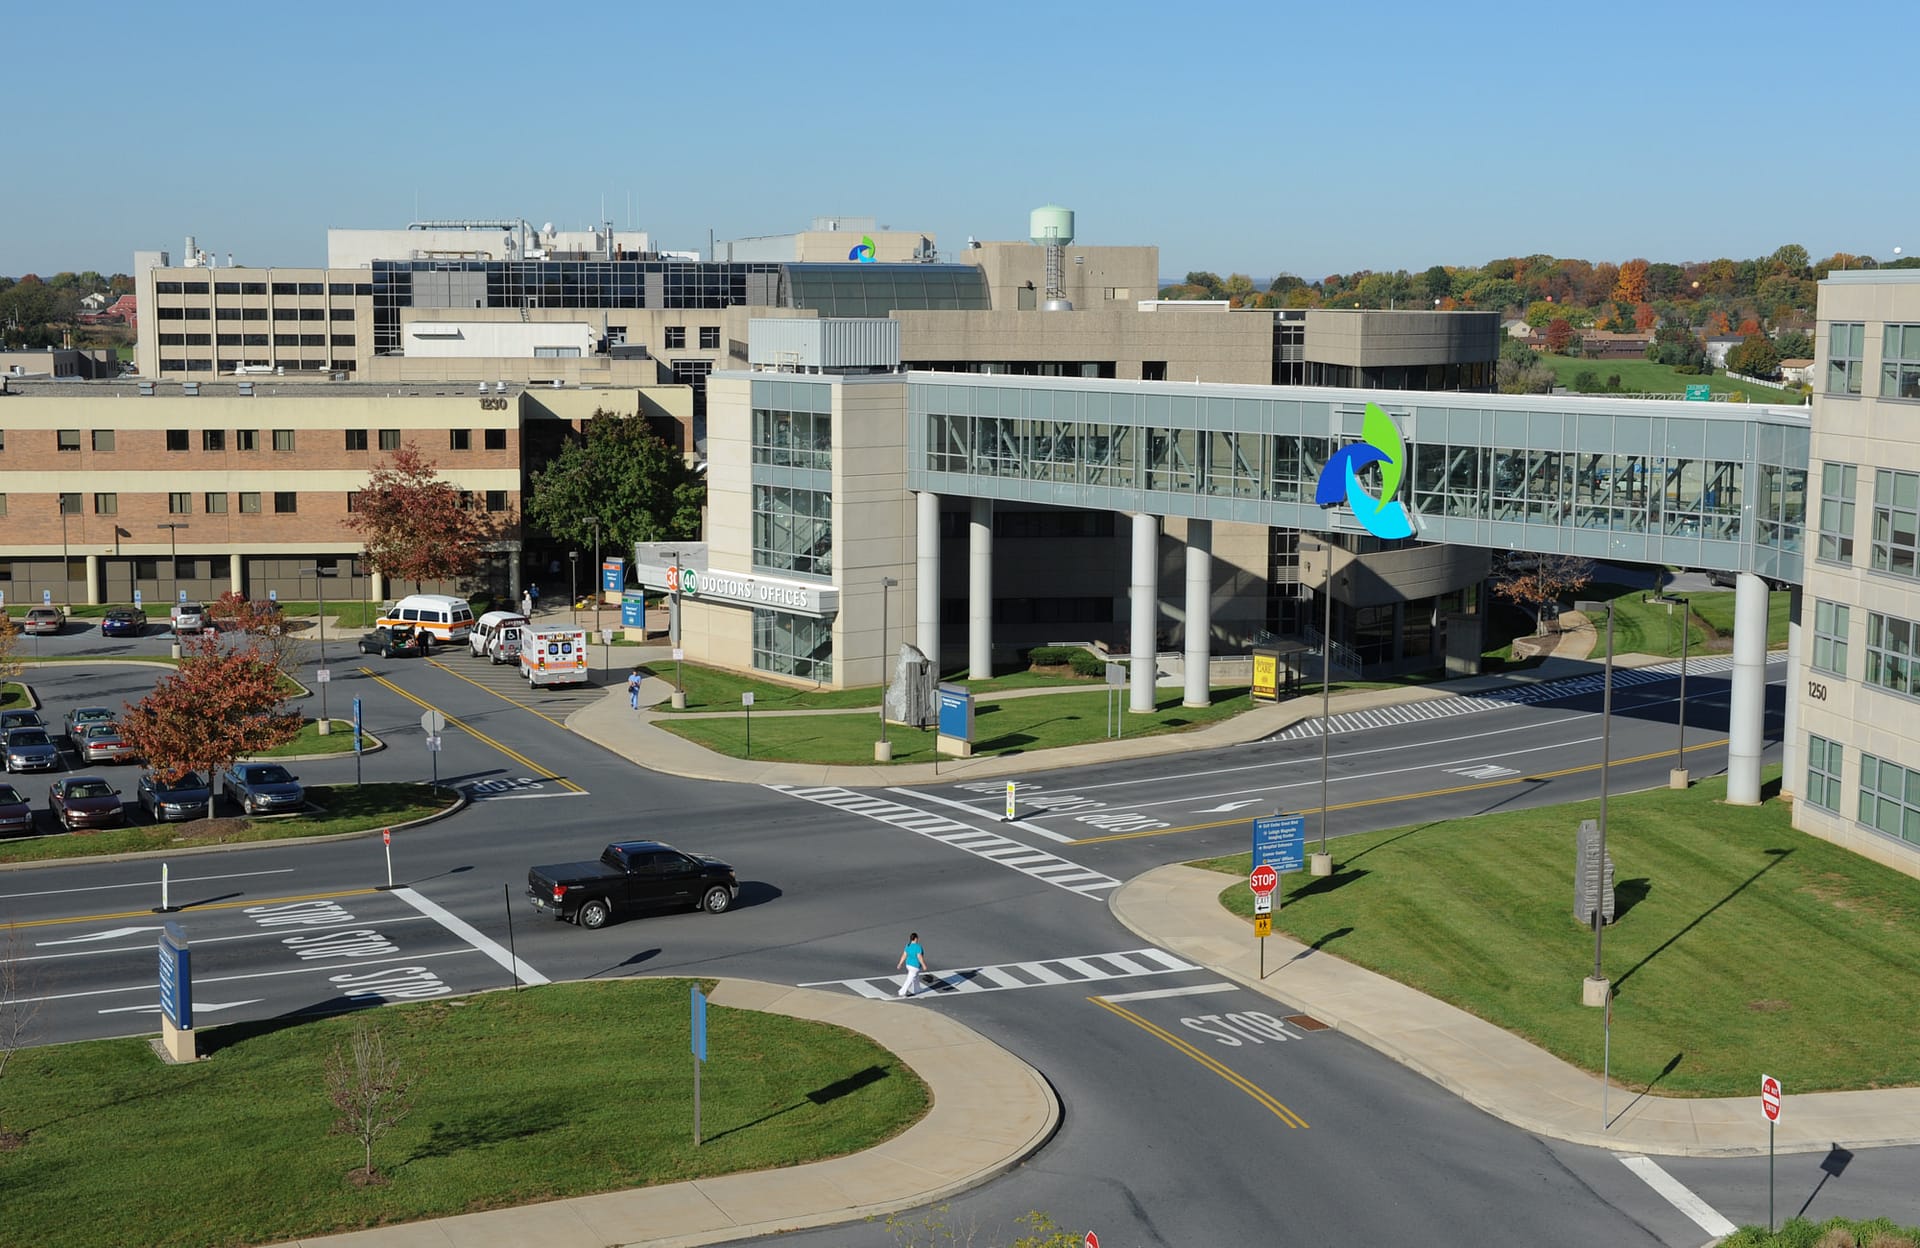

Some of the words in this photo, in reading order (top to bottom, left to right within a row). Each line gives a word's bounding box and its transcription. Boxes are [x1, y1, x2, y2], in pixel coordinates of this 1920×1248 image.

[479, 398, 508, 410] 1230
[684, 575, 697, 589] 40
[702, 576, 755, 599] DOCTORS'
[760, 585, 808, 607] OFFICES
[1808, 681, 1827, 701] 1250
[1075, 813, 1171, 832] STOP
[1252, 874, 1275, 887] STOP
[1256, 896, 1270, 905] EXIT
[243, 901, 355, 927] STOP
[281, 930, 400, 960] STOP
[329, 967, 452, 1000] STOP
[1180, 1011, 1304, 1046] STOP
